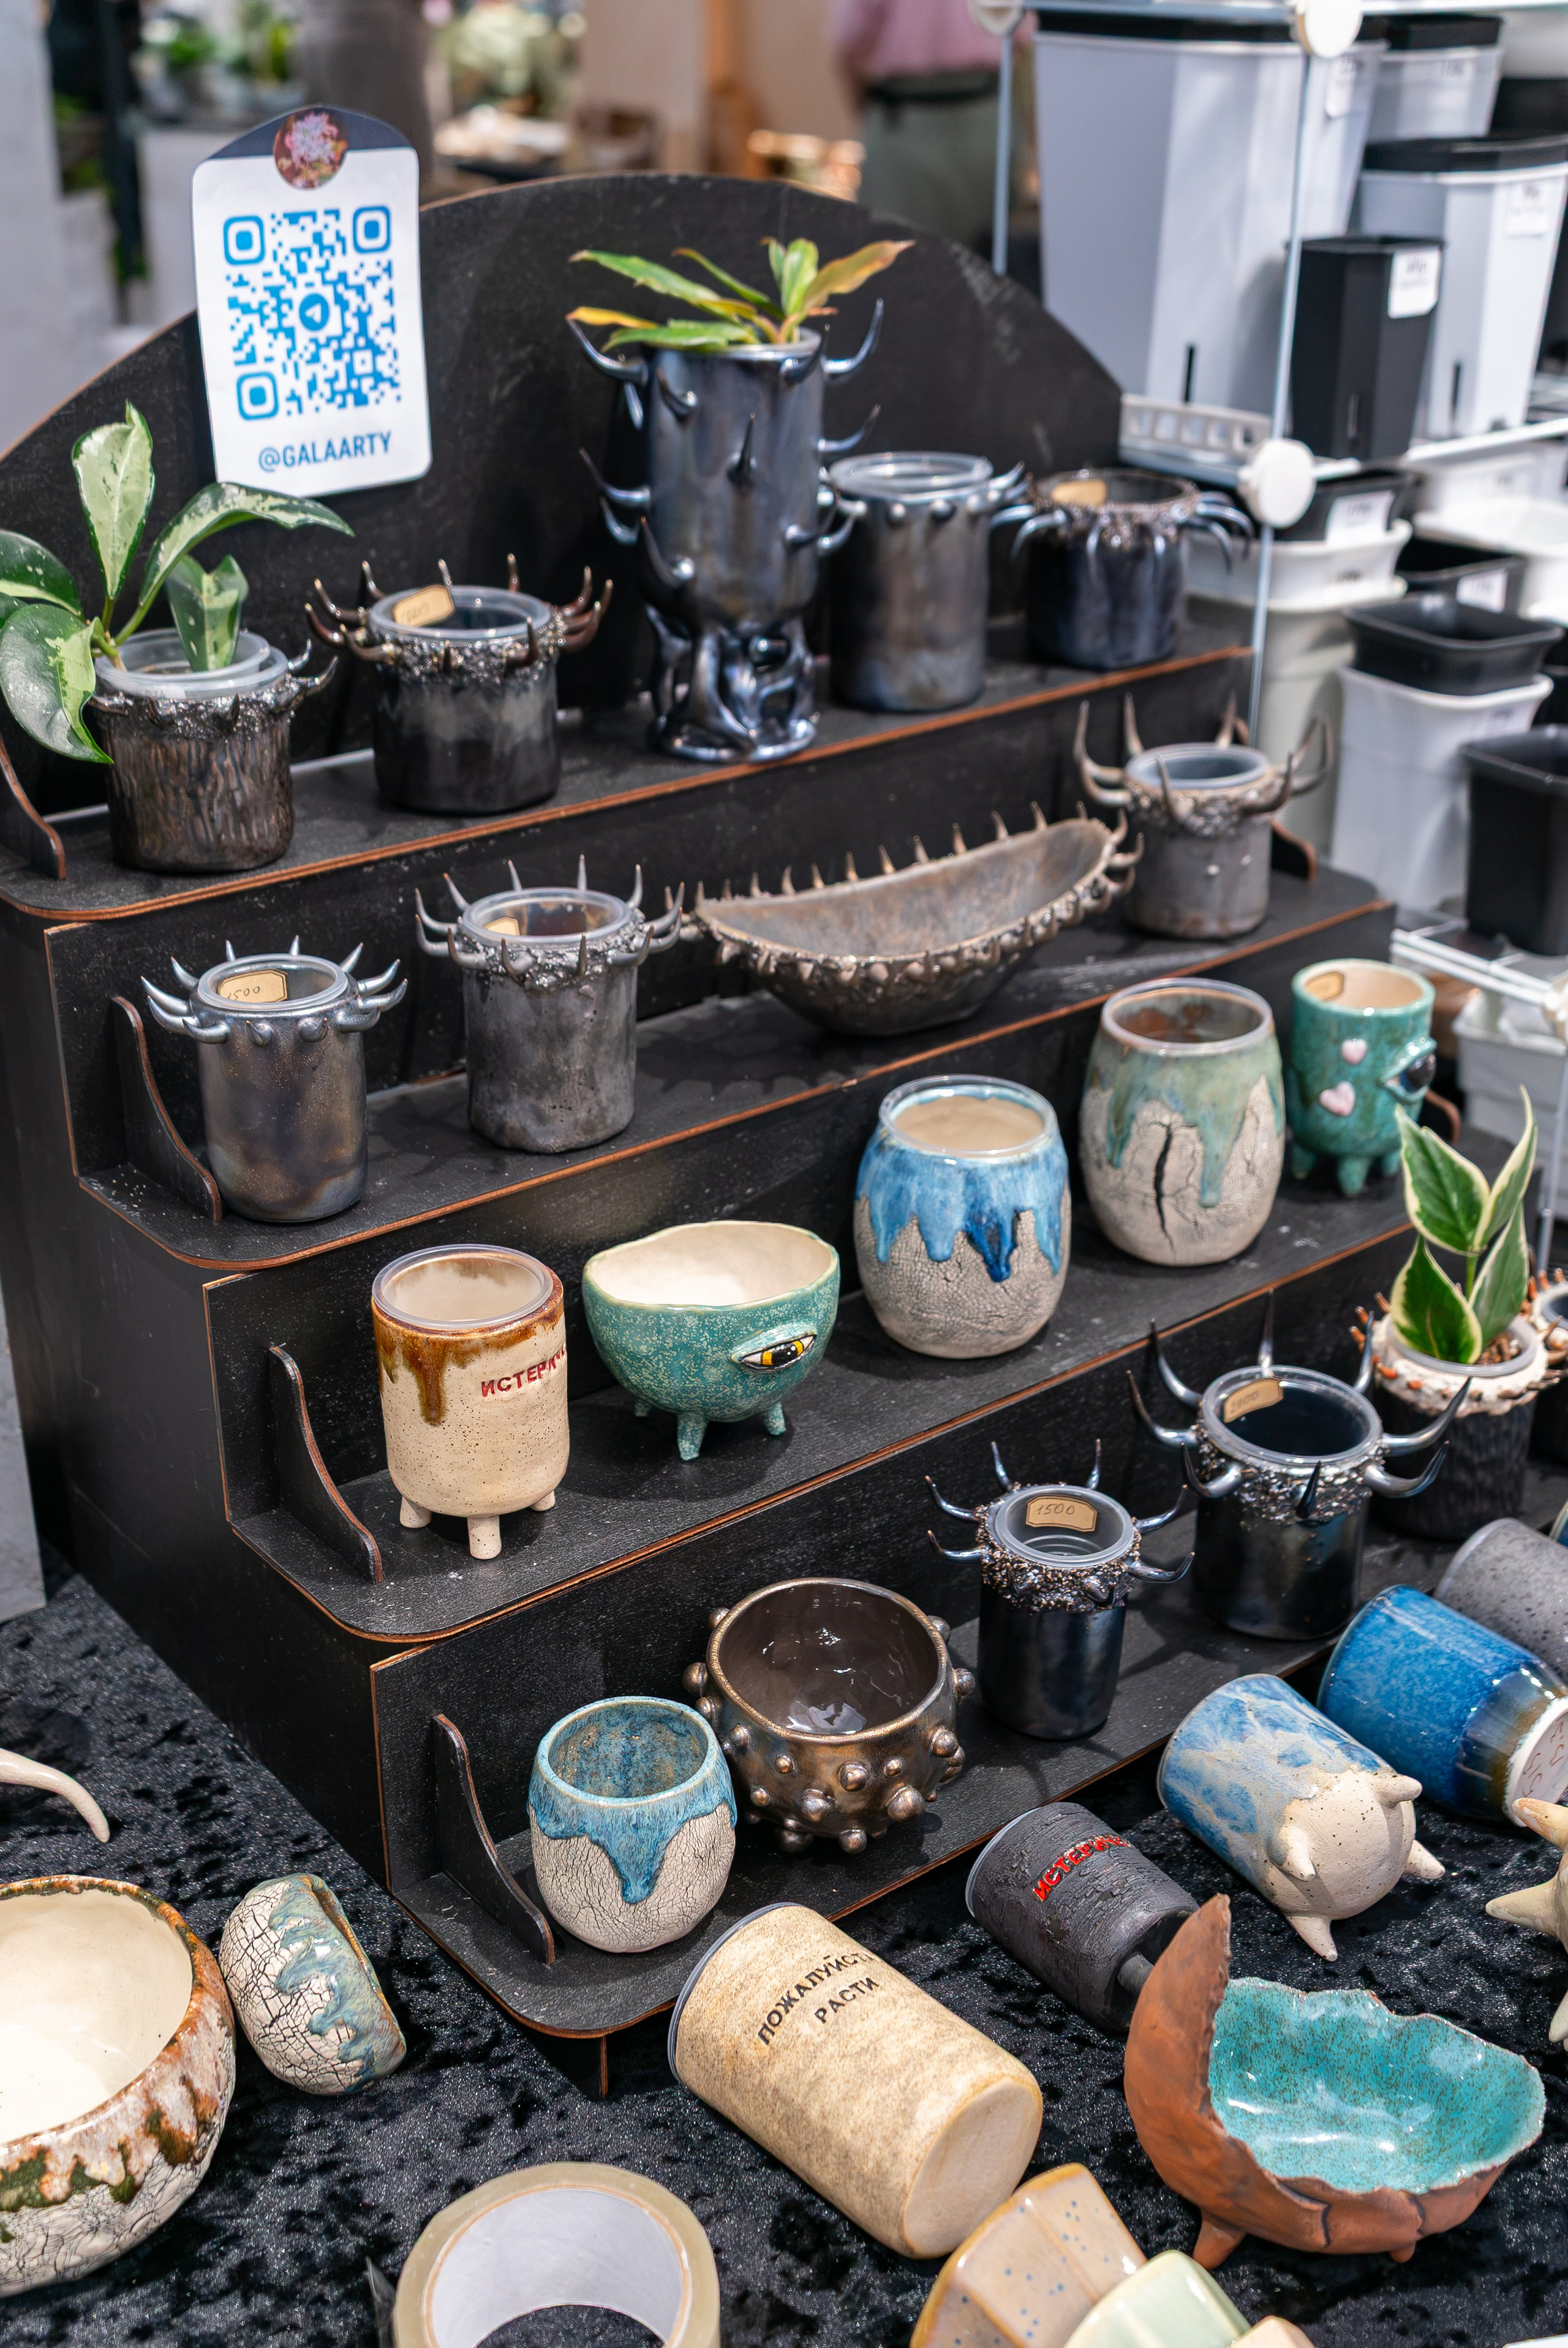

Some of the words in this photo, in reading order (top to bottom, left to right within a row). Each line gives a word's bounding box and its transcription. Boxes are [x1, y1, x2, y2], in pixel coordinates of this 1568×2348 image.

[258, 431, 391, 472] @GALAARTY
[1036, 1503, 1075, 1516] 1500
[758, 1953, 875, 2045] ПОЖАЛУЙСТ
[814, 1977, 879, 2024] РАСТИ
